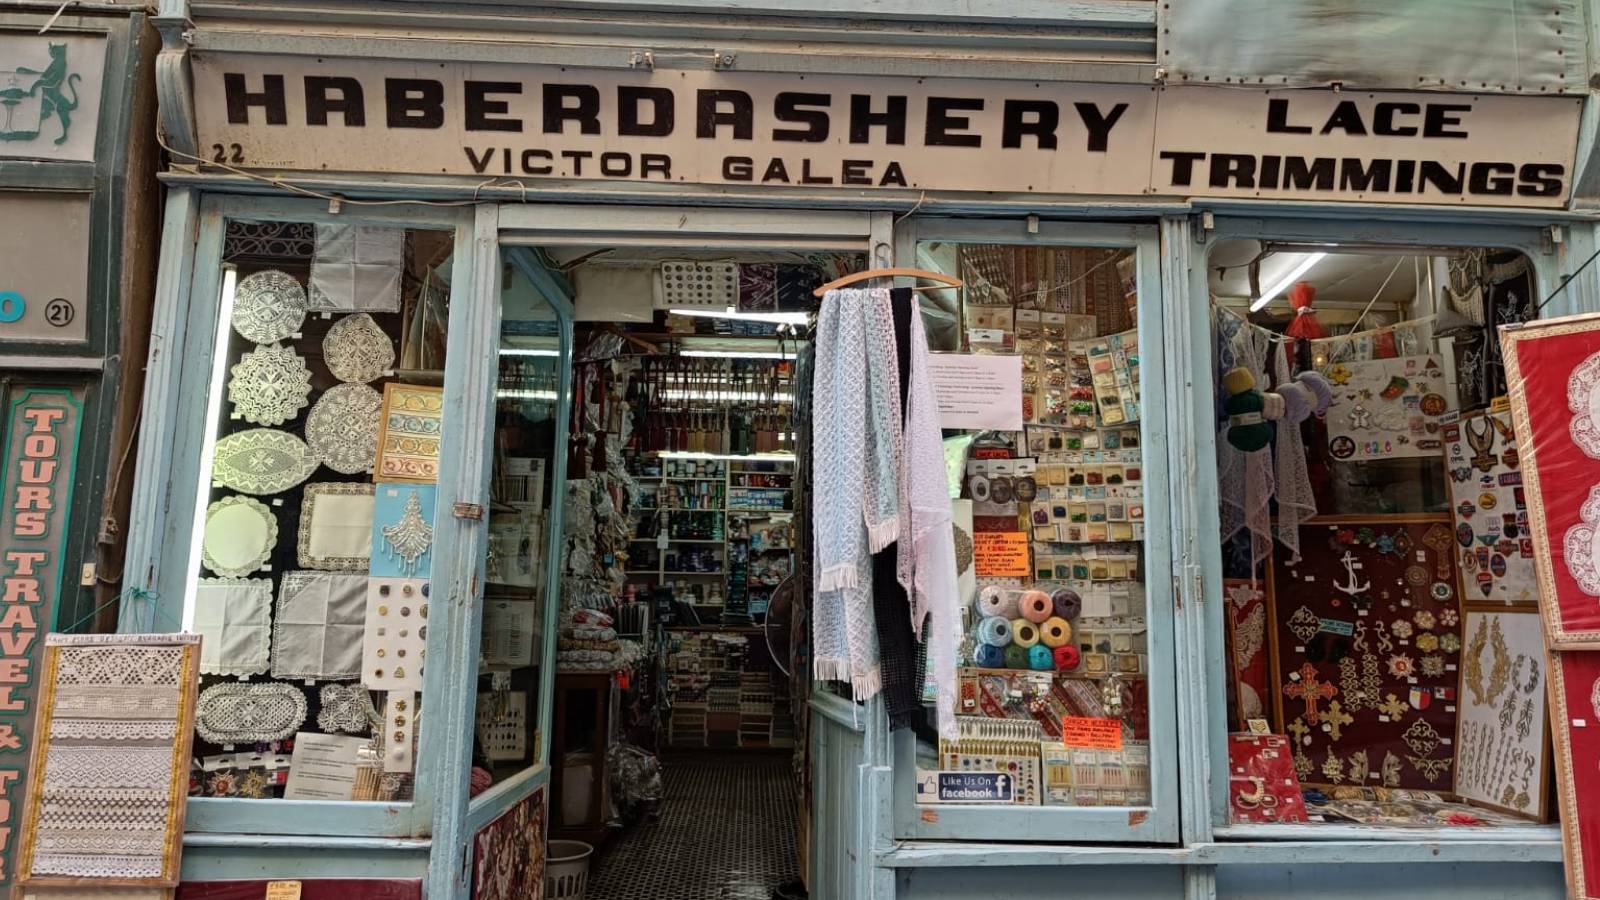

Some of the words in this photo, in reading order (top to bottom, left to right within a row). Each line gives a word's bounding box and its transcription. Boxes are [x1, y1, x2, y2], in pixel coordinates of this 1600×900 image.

[224, 73, 1129, 152] HABERDASHERY
[1266, 99, 1472, 138] LACE
[212, 143, 245, 164] 22
[464, 147, 672, 179] VICTOR
[722, 157, 907, 187] GALEA
[1160, 151, 1564, 197] TRIMMINGS
[50, 304, 69, 321] 21
[15, 408, 64, 536] TOURS
[0, 552, 45, 710] TRAVEL
[942, 775, 961, 786] Like
[964, 775, 976, 786] Us
[977, 776, 991, 786] On
[942, 787, 993, 798] facebook
